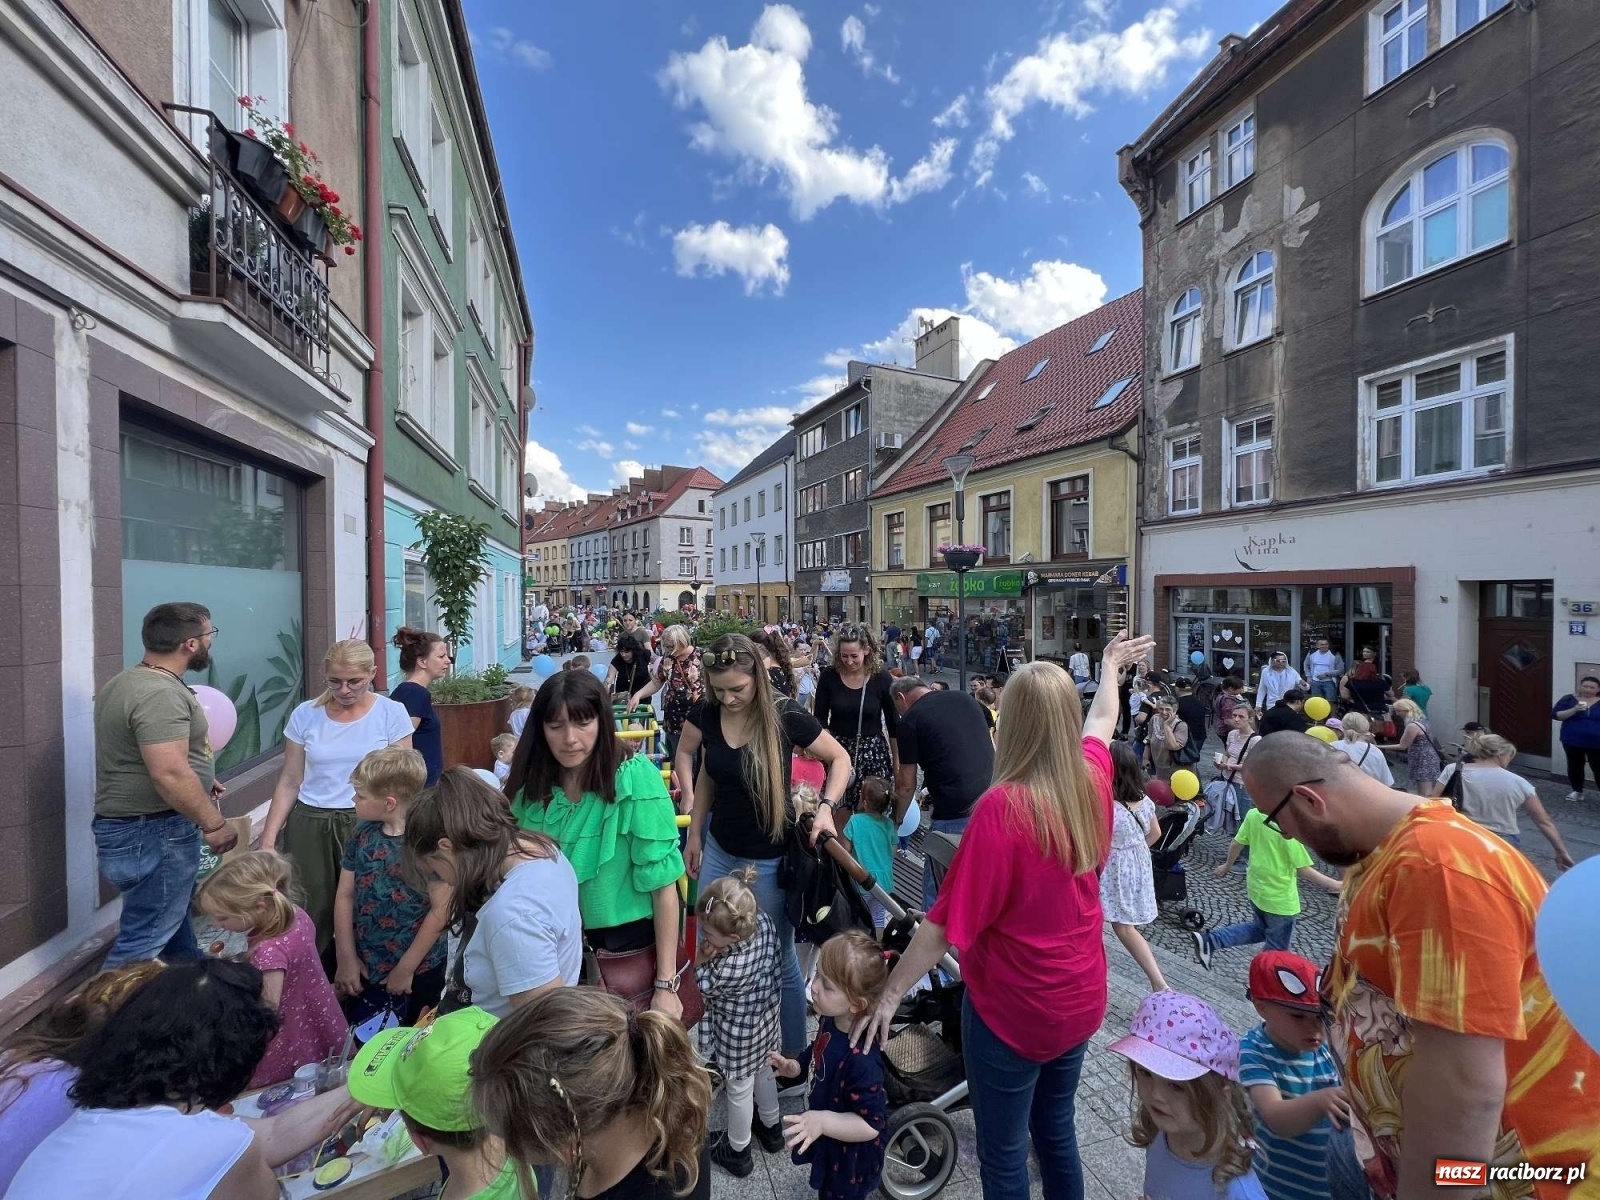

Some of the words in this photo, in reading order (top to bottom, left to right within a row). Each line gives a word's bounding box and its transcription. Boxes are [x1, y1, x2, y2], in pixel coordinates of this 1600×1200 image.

[1248, 532, 1296, 548] Kapka
[1243, 545, 1279, 555] Wina
[1571, 603, 1592, 613] 36
[1571, 625, 1584, 633] 36
